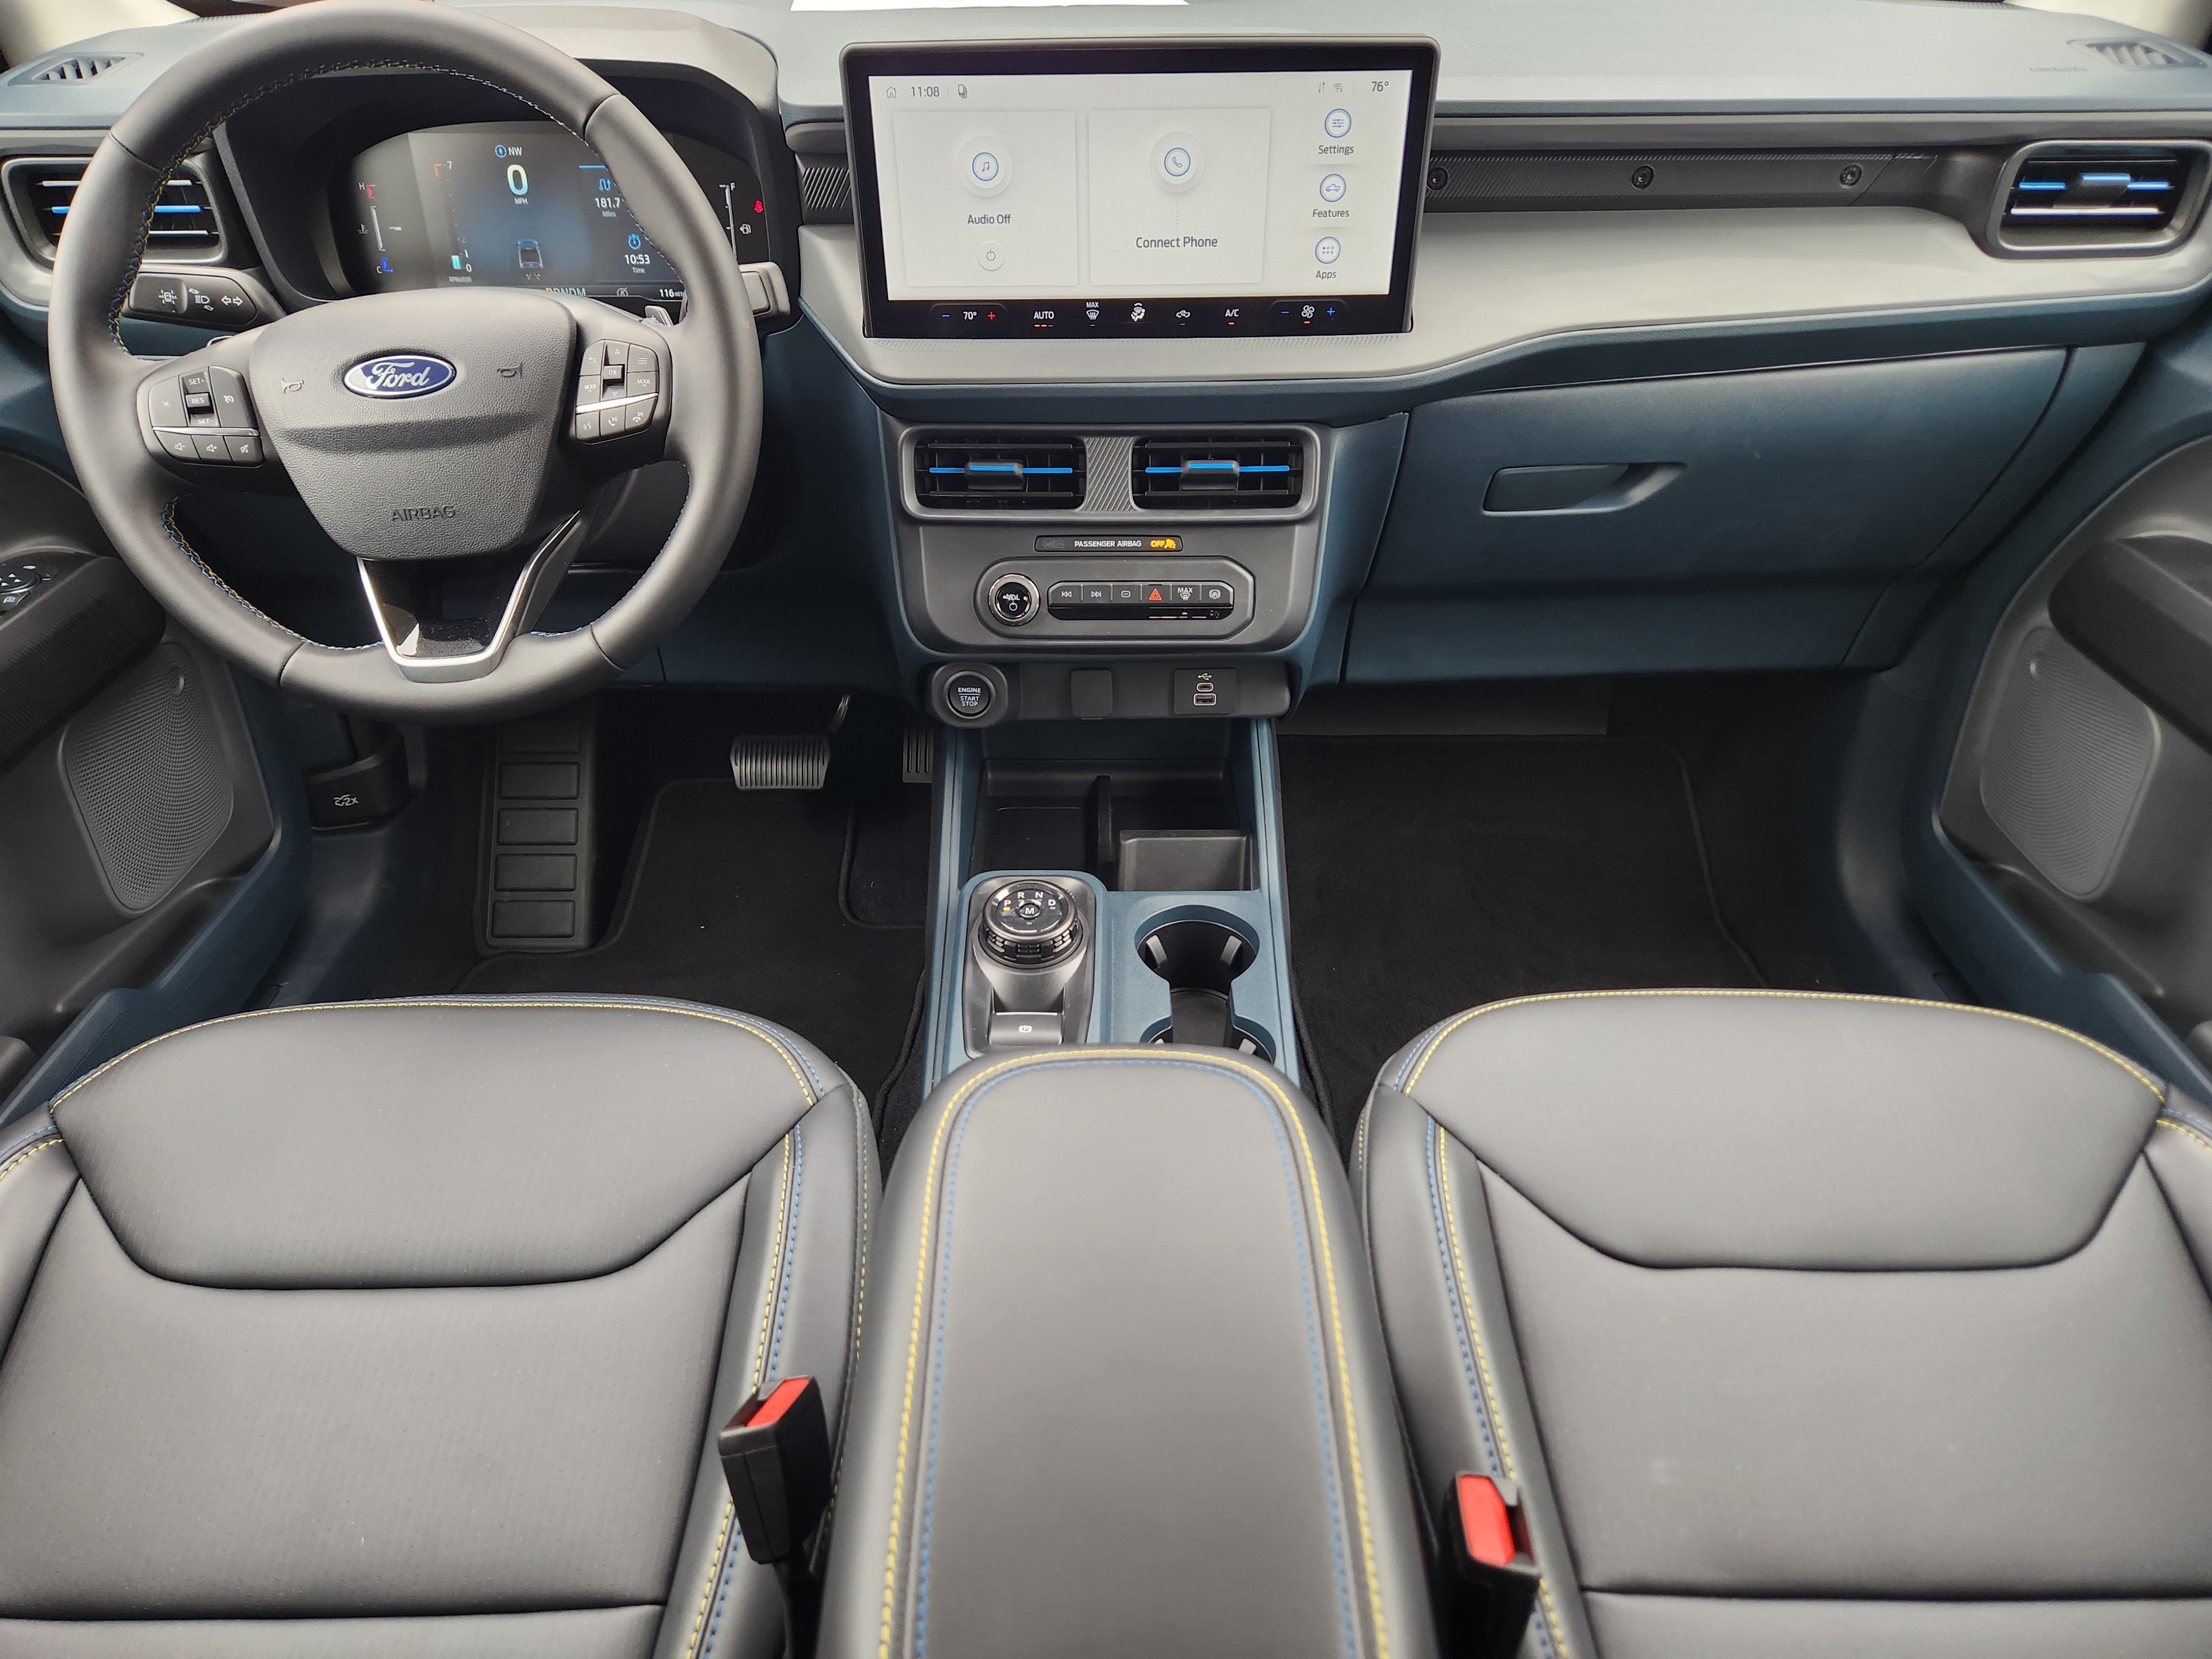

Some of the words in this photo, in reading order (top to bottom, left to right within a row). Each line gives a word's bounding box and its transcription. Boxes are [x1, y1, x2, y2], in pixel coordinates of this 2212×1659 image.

[910, 86, 940, 97] 11:08
[1371, 81, 1389, 92] 76°
[508, 147, 522, 156] NW
[1318, 145, 1354, 156] Settings
[507, 164, 528, 196] 0
[730, 182, 735, 191] F
[594, 197, 620, 208] 181.7
[1312, 208, 1350, 218] Features
[967, 214, 994, 225] Audio
[997, 213, 1011, 225] Off
[1136, 237, 1180, 248] Connect
[1183, 237, 1218, 248] Phone
[464, 249, 469, 258] 1
[624, 254, 650, 265] 10:53
[466, 264, 472, 273] 0
[1316, 270, 1337, 280] Apps
[963, 311, 977, 320] 70°
[1034, 311, 1055, 319] AUTO
[1225, 309, 1240, 317] A/C
[365, 361, 431, 390] Ford
[392, 504, 456, 521] AIRBAG
